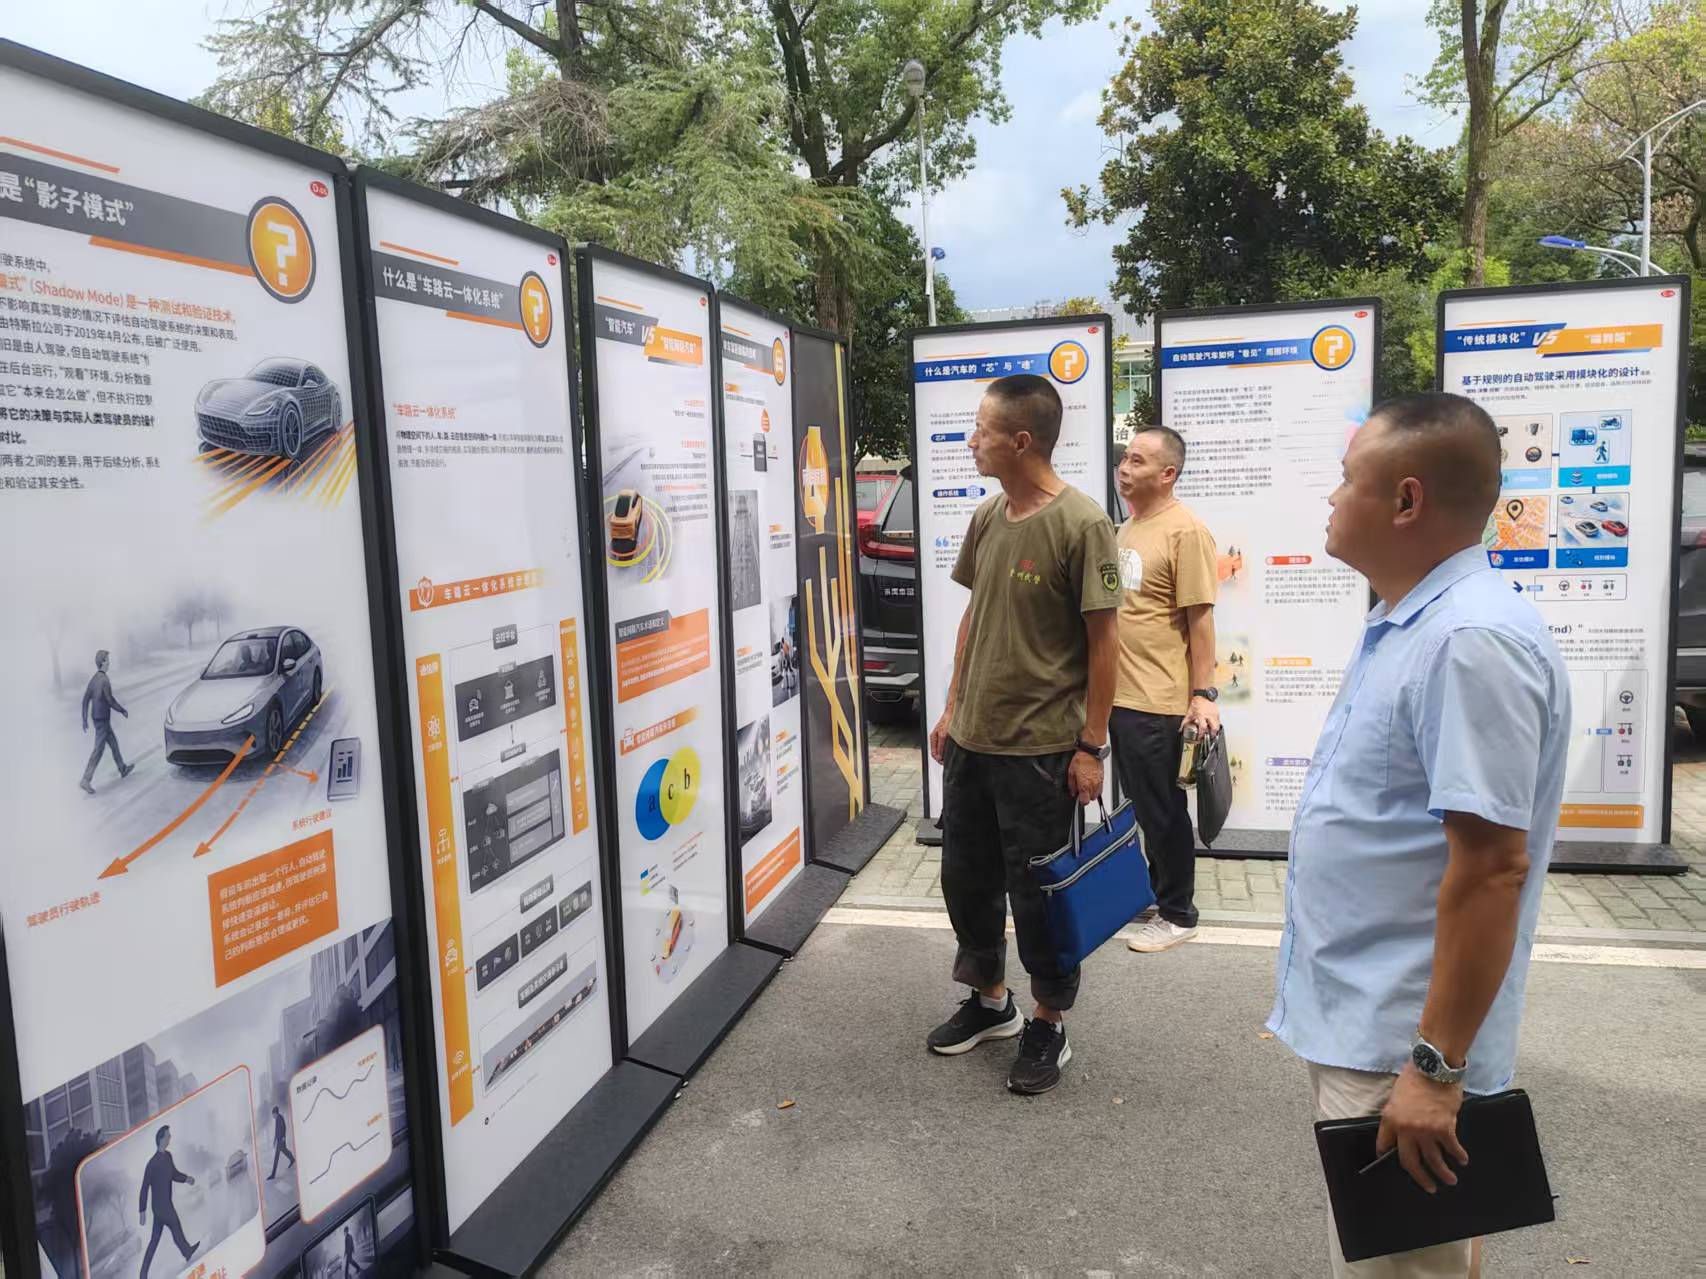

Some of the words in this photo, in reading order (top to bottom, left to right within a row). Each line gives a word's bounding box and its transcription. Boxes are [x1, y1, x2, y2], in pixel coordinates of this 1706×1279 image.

[383, 266, 504, 309] 什么是“车路云一体化系统”
[1457, 331, 1526, 346] “传统模块化”
[1531, 331, 1561, 346] VS
[1461, 366, 1641, 386] 基于规则的自动驾驶采用模块化的设计
[1115, 427, 1129, 441] 治
[683, 768, 691, 790] b
[667, 783, 674, 800] c
[648, 794, 656, 812] a
